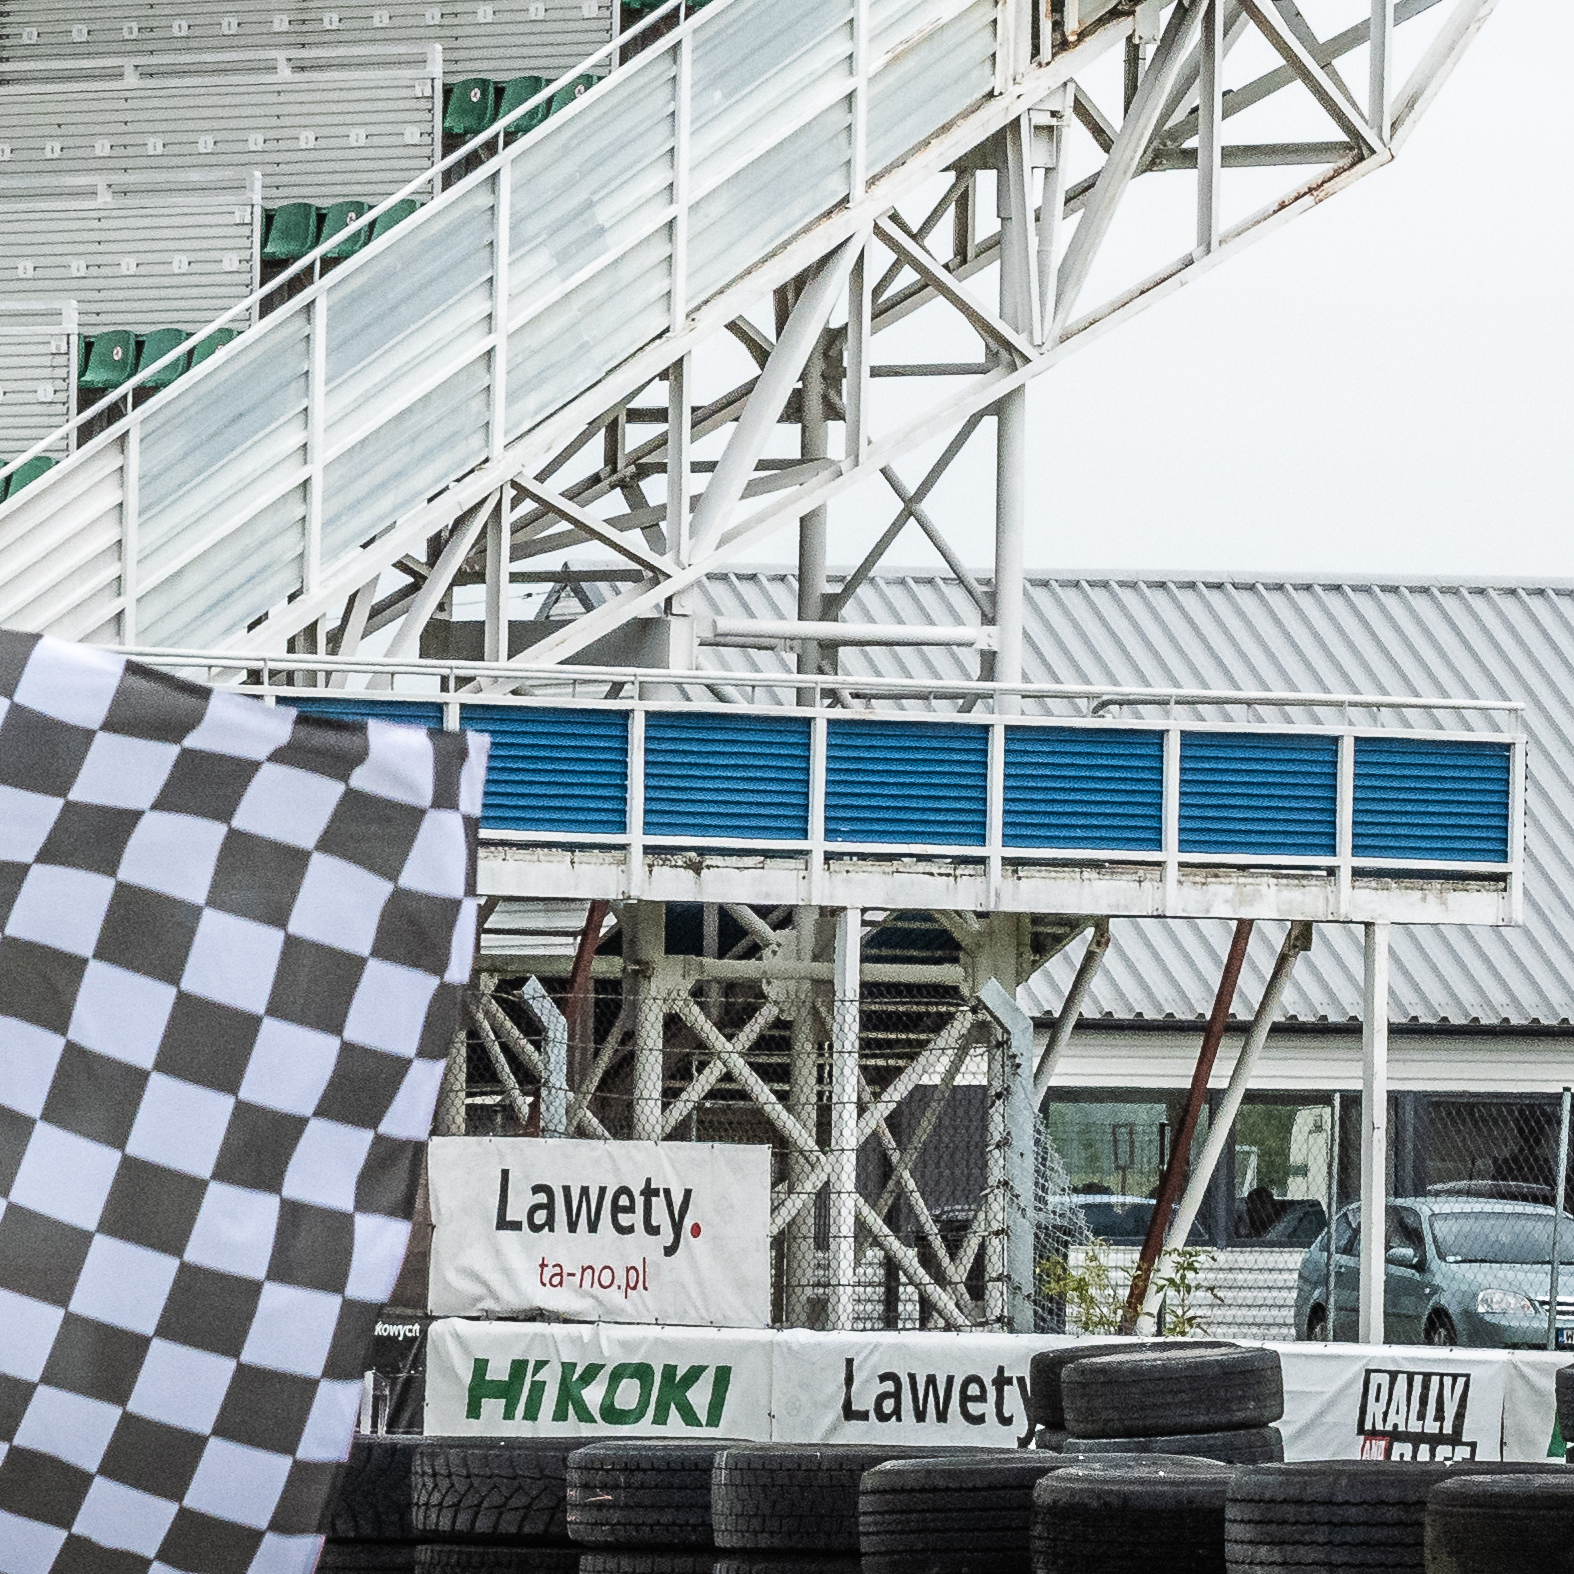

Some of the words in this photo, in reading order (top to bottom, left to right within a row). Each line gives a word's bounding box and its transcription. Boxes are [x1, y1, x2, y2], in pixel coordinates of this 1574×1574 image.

[495, 1168, 702, 1257] Lawety.
[538, 1257, 648, 1299] ta-no.pl
[1365, 1373, 1468, 1434] RALLY
